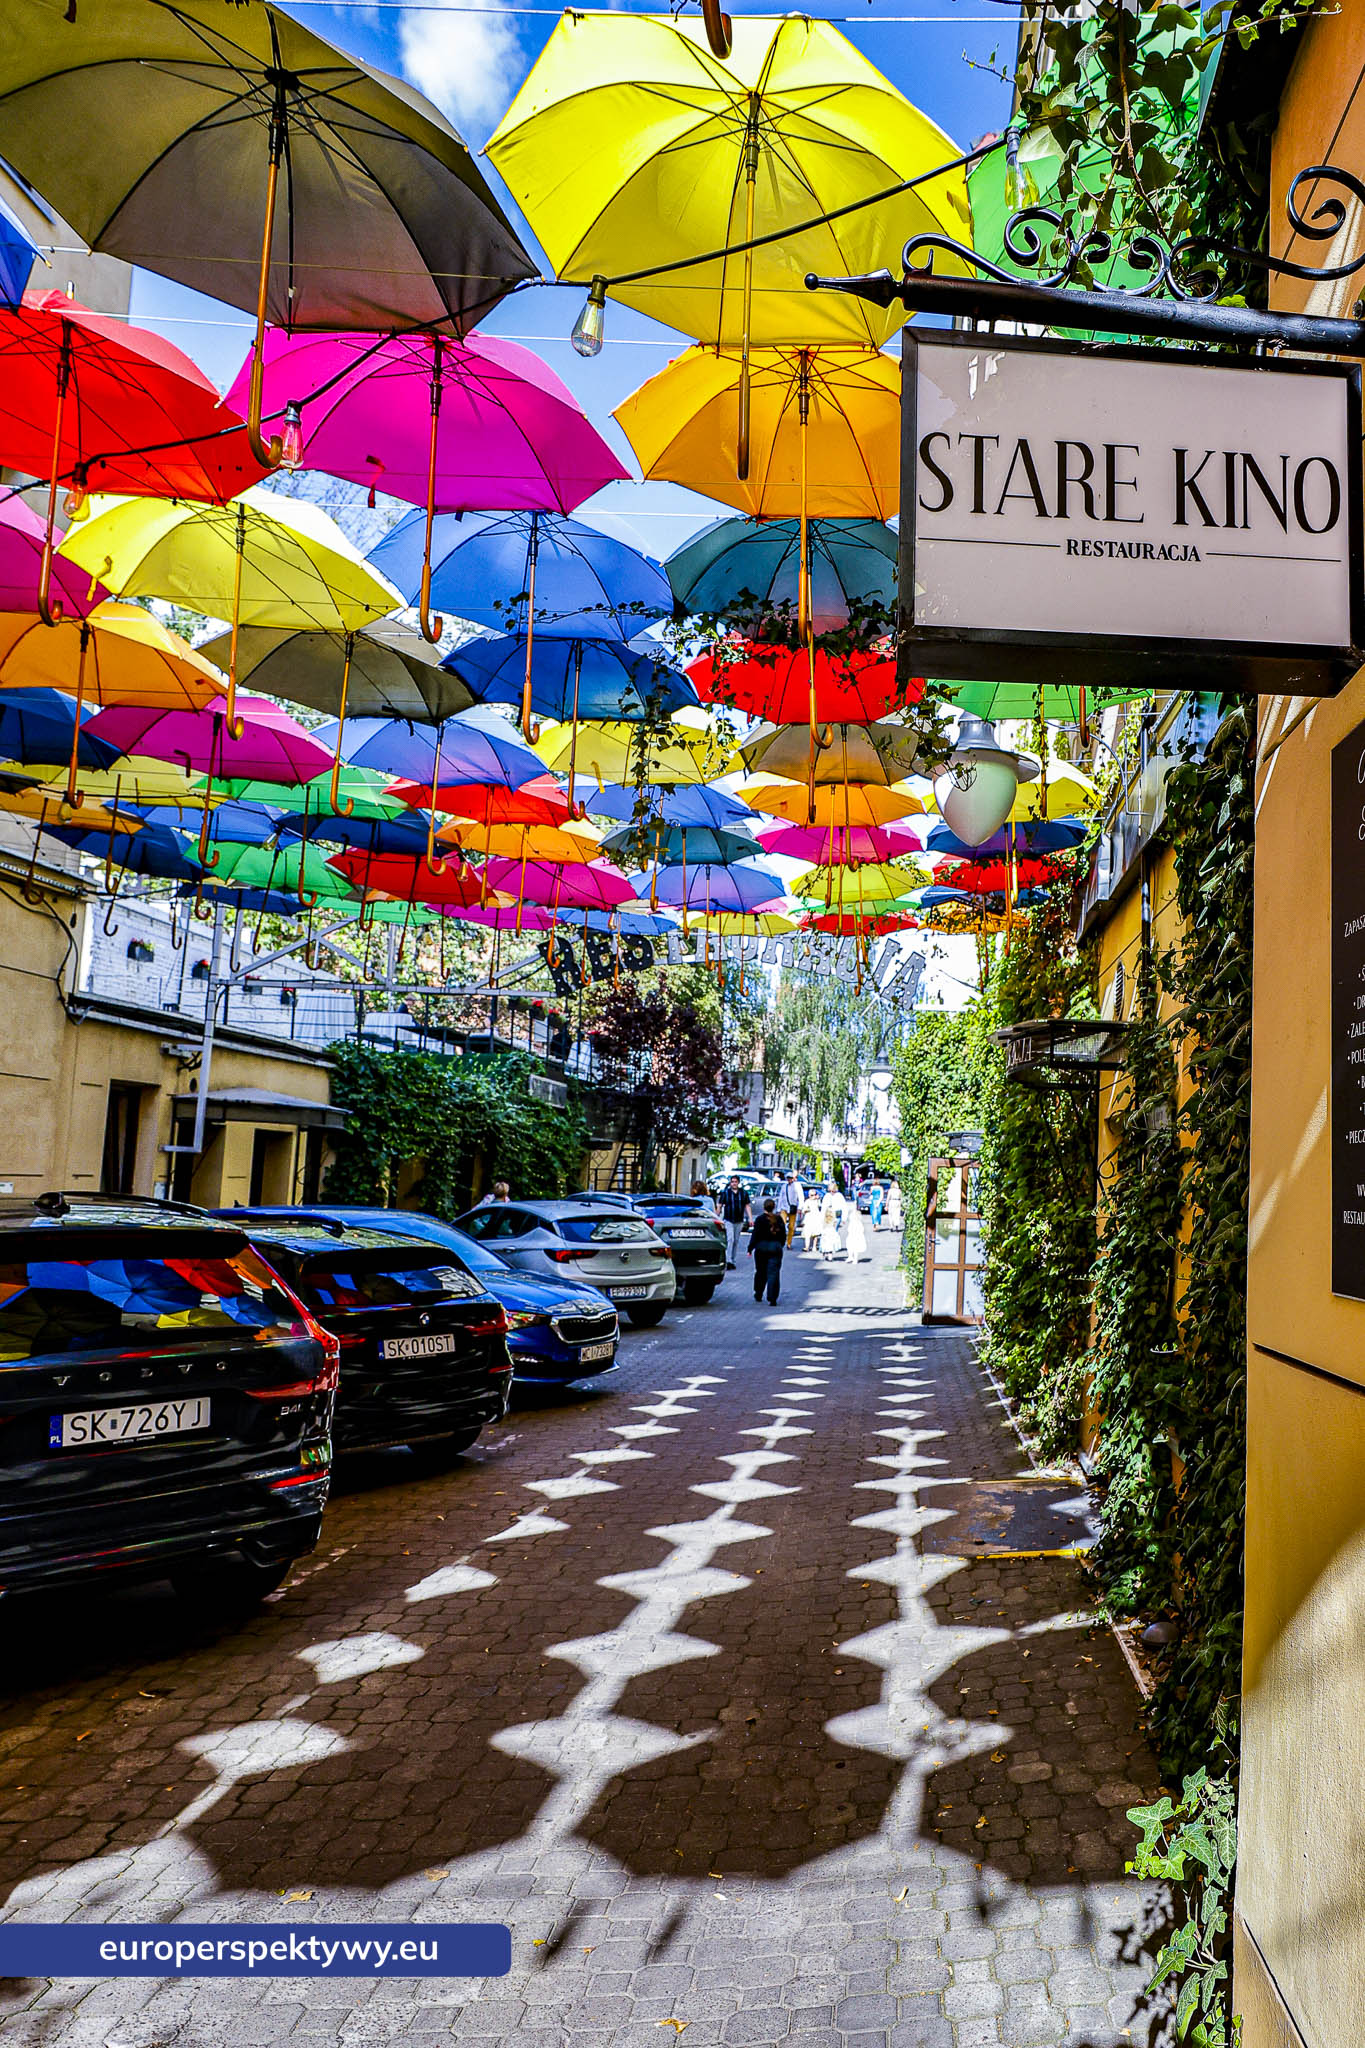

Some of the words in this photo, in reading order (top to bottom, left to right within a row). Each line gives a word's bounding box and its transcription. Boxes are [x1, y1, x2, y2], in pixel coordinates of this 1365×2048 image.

[919, 432, 1145, 523] STARE
[1172, 448, 1342, 534] KINO
[1066, 538, 1202, 562] RESTAURACJA
[387, 1339, 406, 1357] SK
[70, 1411, 108, 1442] SK
[120, 1400, 202, 1437] 726YJ
